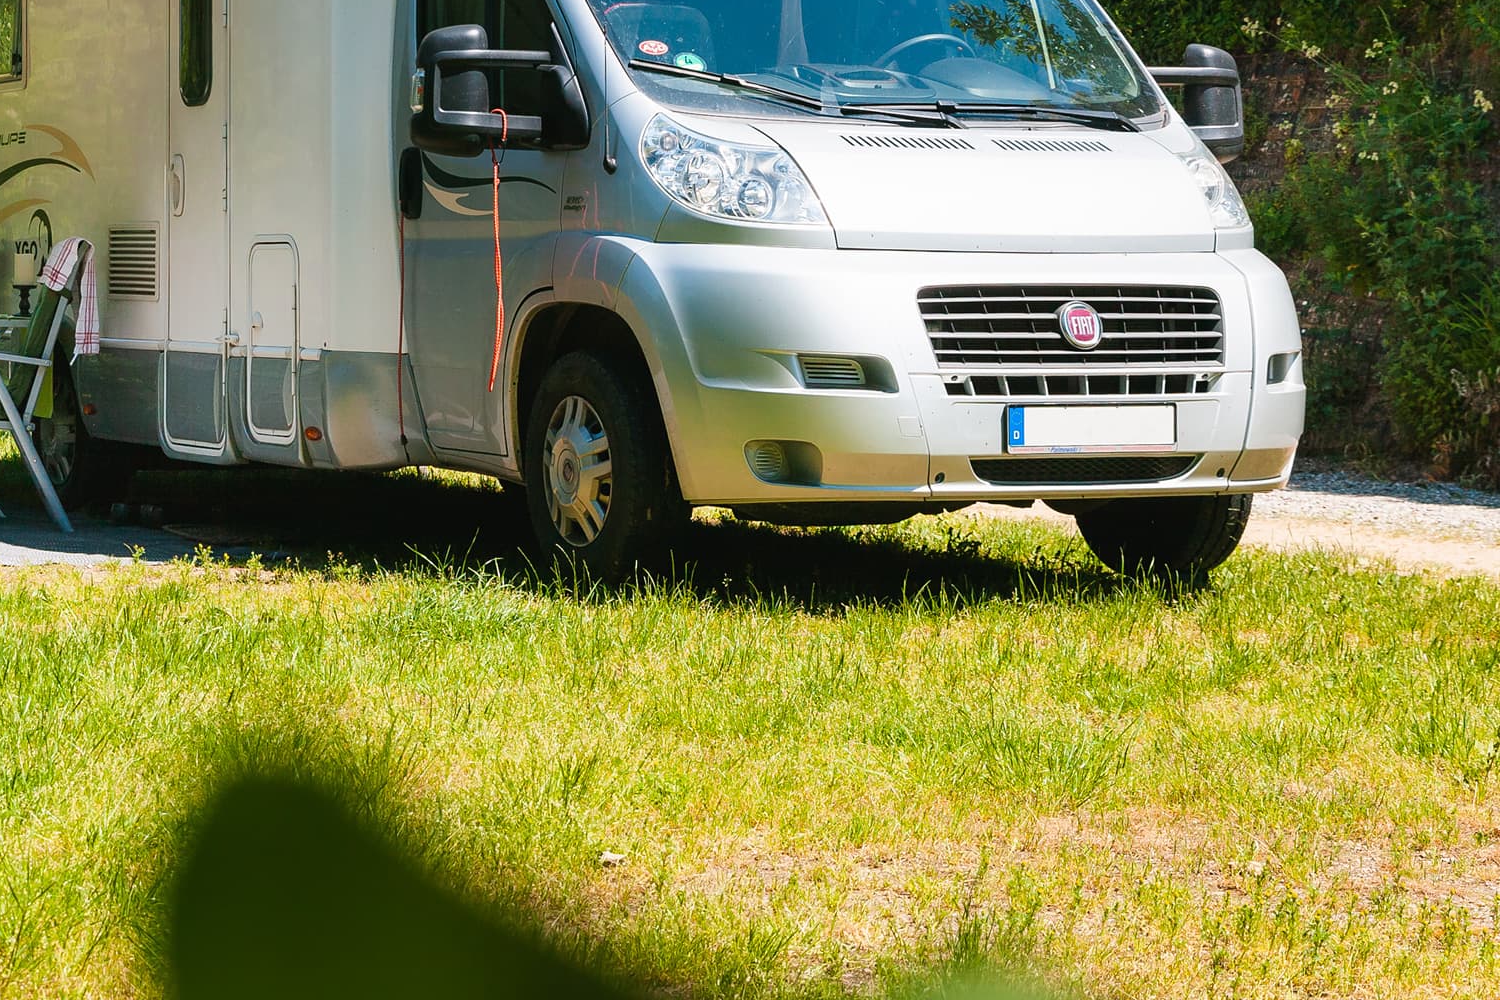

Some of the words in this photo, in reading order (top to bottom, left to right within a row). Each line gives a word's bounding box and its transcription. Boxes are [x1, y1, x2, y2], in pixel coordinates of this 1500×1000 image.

[684, 55, 693, 65] 4
[1071, 315, 1094, 336] FIAT
[1013, 430, 1020, 440] D
